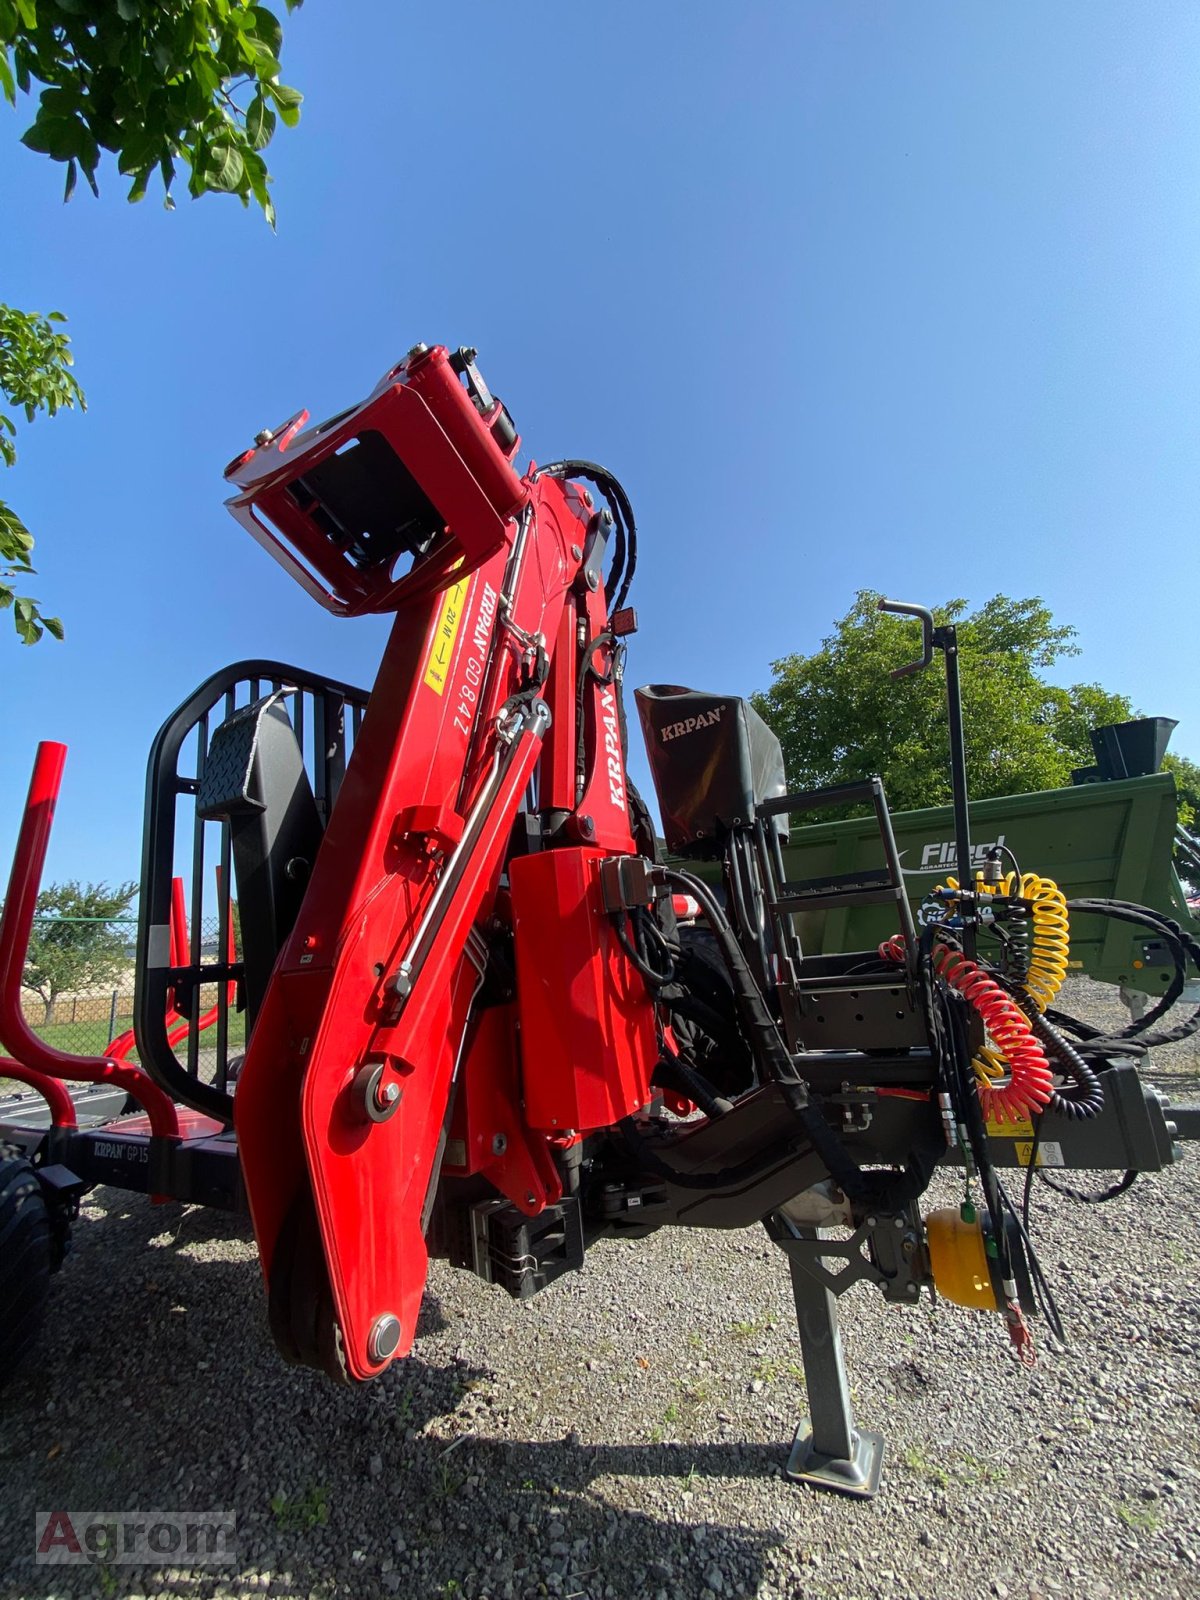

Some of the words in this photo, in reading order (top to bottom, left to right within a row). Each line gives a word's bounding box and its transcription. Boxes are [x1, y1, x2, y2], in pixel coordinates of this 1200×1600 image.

[442, 624, 452, 639] M
[446, 607, 456, 625] 20
[473, 582, 497, 653] KRPAN
[465, 656, 483, 687] GD
[661, 706, 721, 742] KRPAN
[601, 689, 625, 811] KRPAN
[94, 1141, 123, 1159] KRPAN
[127, 1145, 138, 1161] GP
[139, 1146, 149, 1163] 15
